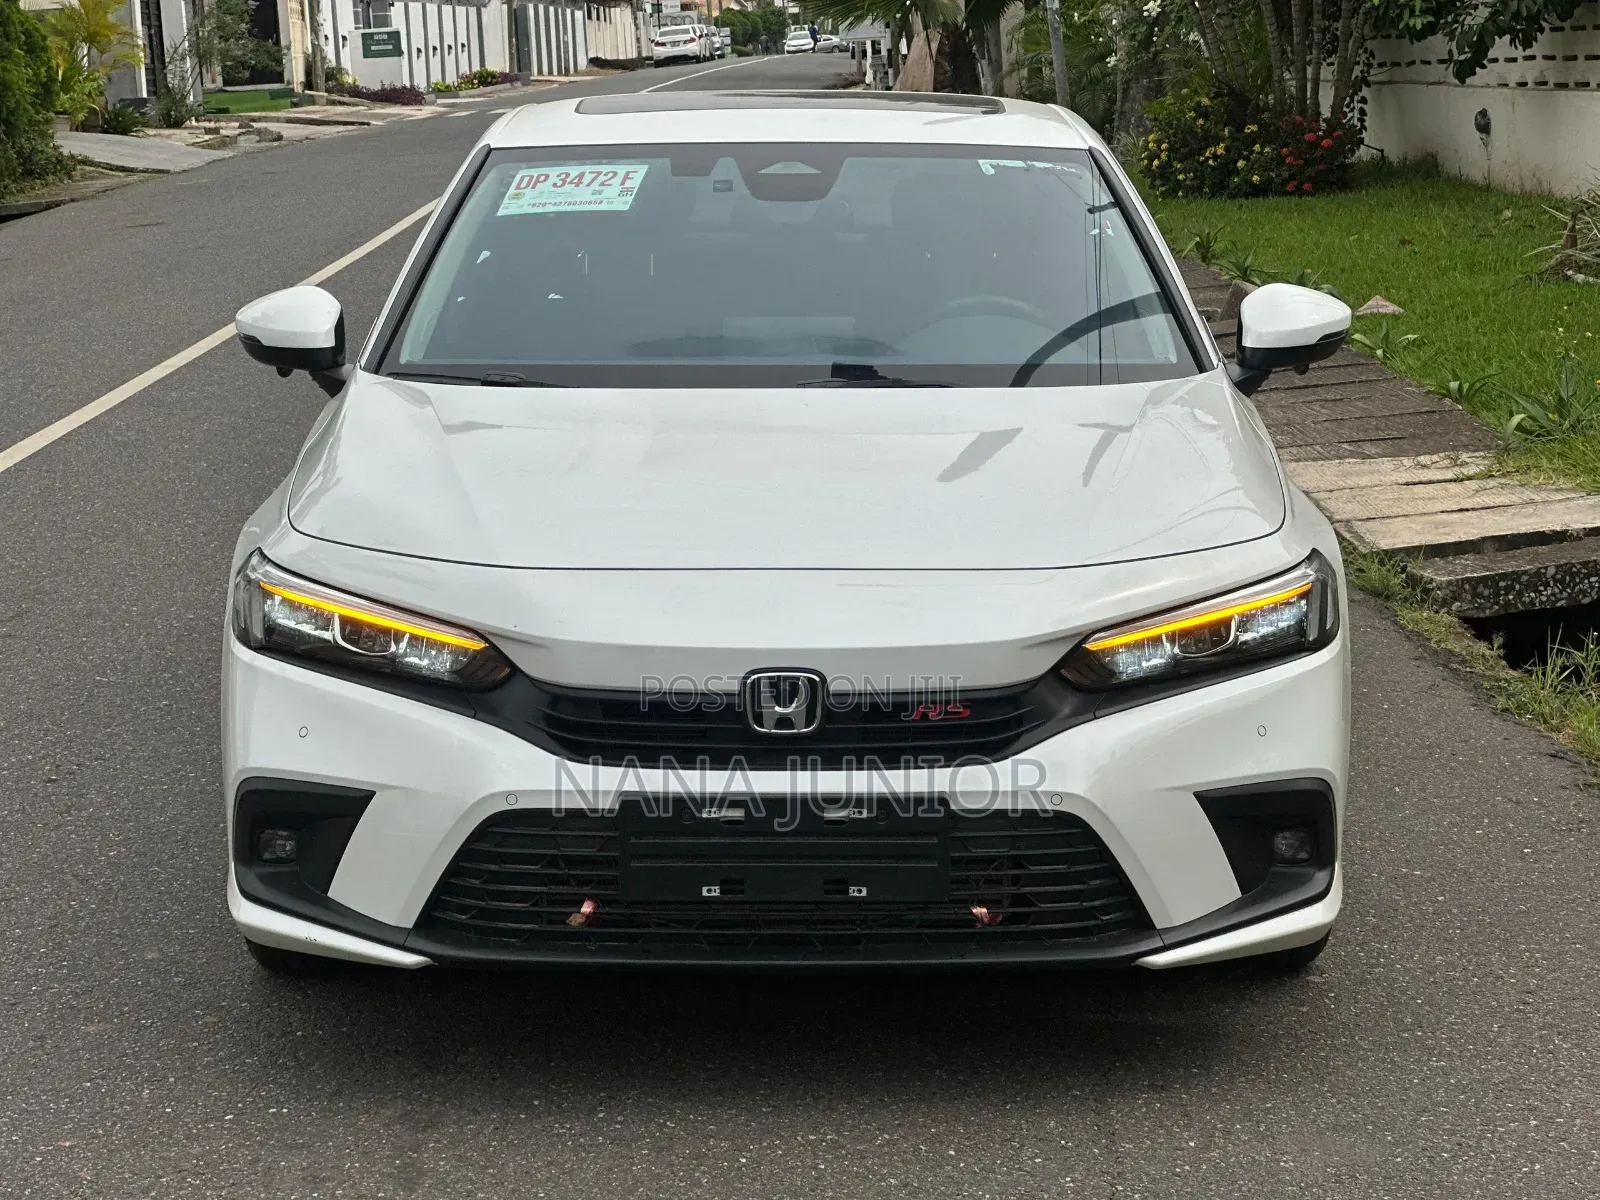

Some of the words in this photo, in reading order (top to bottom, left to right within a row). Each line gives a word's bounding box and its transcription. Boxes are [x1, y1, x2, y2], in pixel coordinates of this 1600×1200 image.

[514, 173, 550, 191] DP
[552, 170, 618, 188] 3472
[619, 170, 639, 187] F
